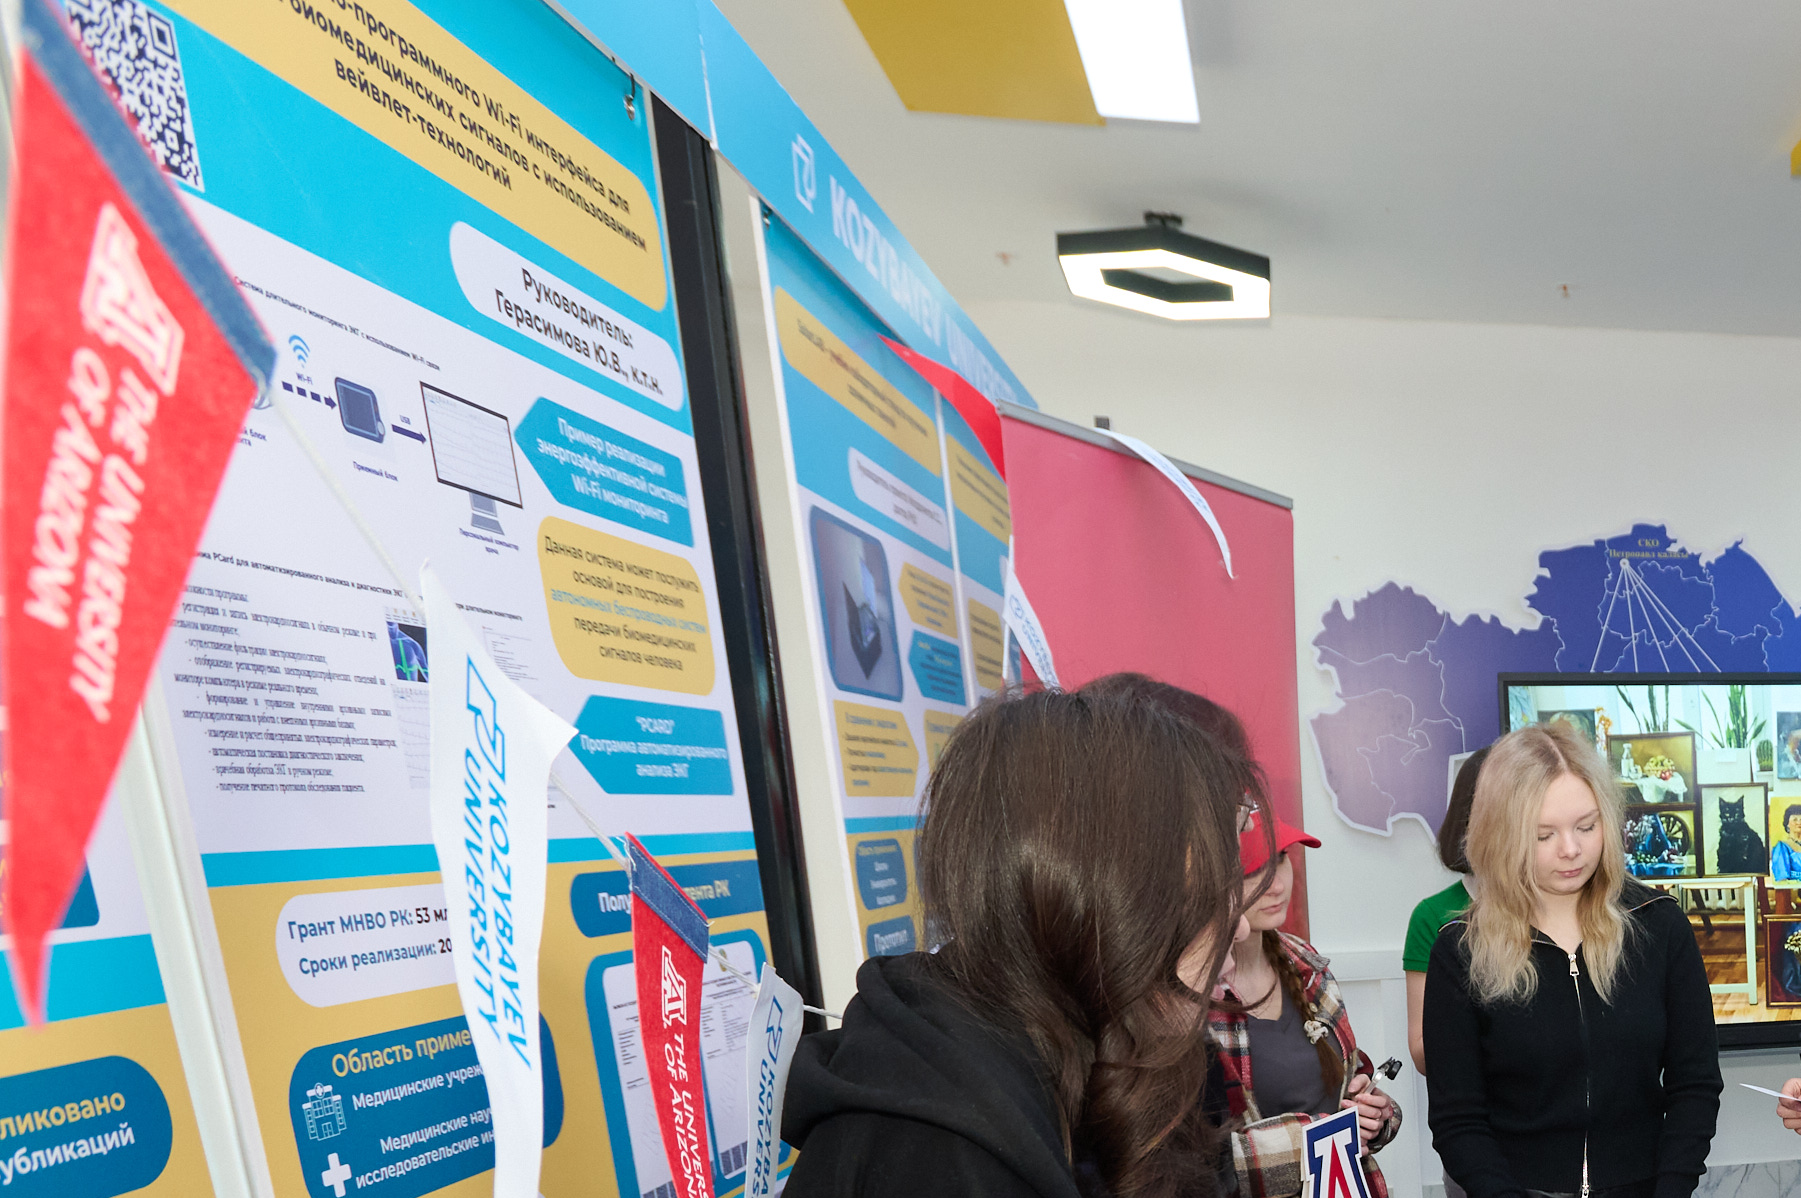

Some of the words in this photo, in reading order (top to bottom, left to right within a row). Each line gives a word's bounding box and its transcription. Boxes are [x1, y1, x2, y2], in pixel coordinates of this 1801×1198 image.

[334, 58, 512, 190] вейвлет-технологий
[482, 93, 523, 139] Wi-Fi
[525, 126, 605, 197] интерфейса
[608, 184, 631, 215] для
[459, 110, 530, 172] сигналов
[532, 163, 542, 180] с
[543, 170, 648, 253] использованием
[522, 267, 634, 350] Руководитель:
[495, 288, 590, 358] Герасимова
[593, 340, 630, 384] Ю.В.,
[630, 365, 663, 395] к.т.н.
[68, 346, 112, 428] OF
[296, 372, 313, 386] Wi-Fi
[109, 368, 159, 466] THE
[400, 414, 411, 426] USB
[537, 437, 647, 493] энергоэффективной
[557, 416, 604, 452] Пример
[605, 441, 666, 477] реализации
[24, 402, 104, 632] ARIZONA
[571, 473, 600, 500] Wi-Fi
[602, 488, 669, 525] мониторинга
[70, 453, 145, 724] UNIVERSITY
[213, 552, 235, 565] PCard
[236, 558, 250, 568] для
[250, 560, 324, 582] автоматизированного
[545, 535, 583, 561] Данная
[586, 548, 624, 572] система
[626, 561, 654, 580] может
[655, 570, 700, 593] послужить
[573, 570, 614, 592] основой
[616, 582, 632, 597] для
[634, 586, 685, 609] построения
[551, 588, 612, 614] автономных
[614, 599, 676, 628] беспроводных
[574, 617, 621, 638] передачи
[624, 623, 697, 653] биомедицинских
[599, 646, 642, 662] сигналов
[643, 654, 683, 671] человека
[580, 733, 637, 756] Программа
[463, 746, 501, 1048] UNIVERSITY
[598, 892, 632, 913] Полу
[716, 880, 730, 898] РК
[288, 918, 335, 943] Грант
[340, 911, 387, 934] МНВО
[390, 908, 413, 927] РК:
[416, 907, 431, 925] 53
[487, 778, 533, 1072] KOZYBAYEV
[299, 952, 347, 978] Сроки
[351, 943, 436, 972] реализации:
[332, 1040, 414, 1078] Область
[664, 1044, 678, 1081] OF
[674, 1033, 689, 1084] THE
[0, 1092, 126, 1141] ликовано
[352, 1071, 445, 1111] Медицинские
[0, 1122, 136, 1186] убликаций
[380, 1115, 469, 1154] Медицинские
[355, 1136, 480, 1189] исследовательские
